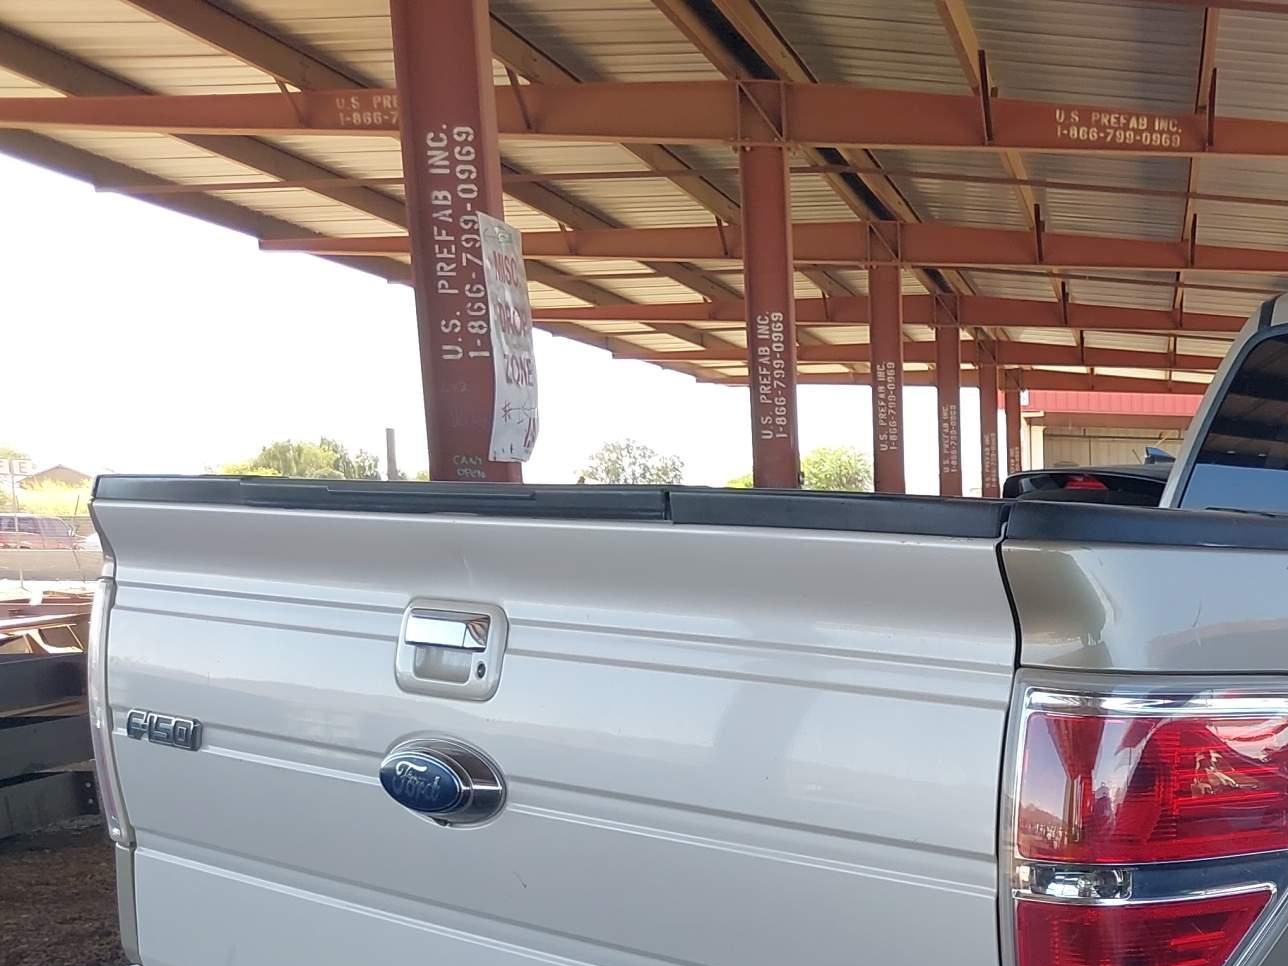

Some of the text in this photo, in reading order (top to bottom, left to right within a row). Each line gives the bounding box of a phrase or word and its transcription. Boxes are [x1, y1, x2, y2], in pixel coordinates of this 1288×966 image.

[1056, 125, 1181, 147] 1-866-799-0969
[1091, 111, 1148, 130] PREFAB
[1154, 117, 1183, 133] INC.
[426, 124, 464, 360] U.S. PREFAB INC.
[453, 126, 490, 358] 1-866-799-0969
[756, 311, 770, 339] INC.
[503, 353, 535, 387] ZONE
[758, 346, 773, 403] PREFAB
[771, 312, 788, 438] 1-866-799-0969
[395, 760, 441, 801] Ford
